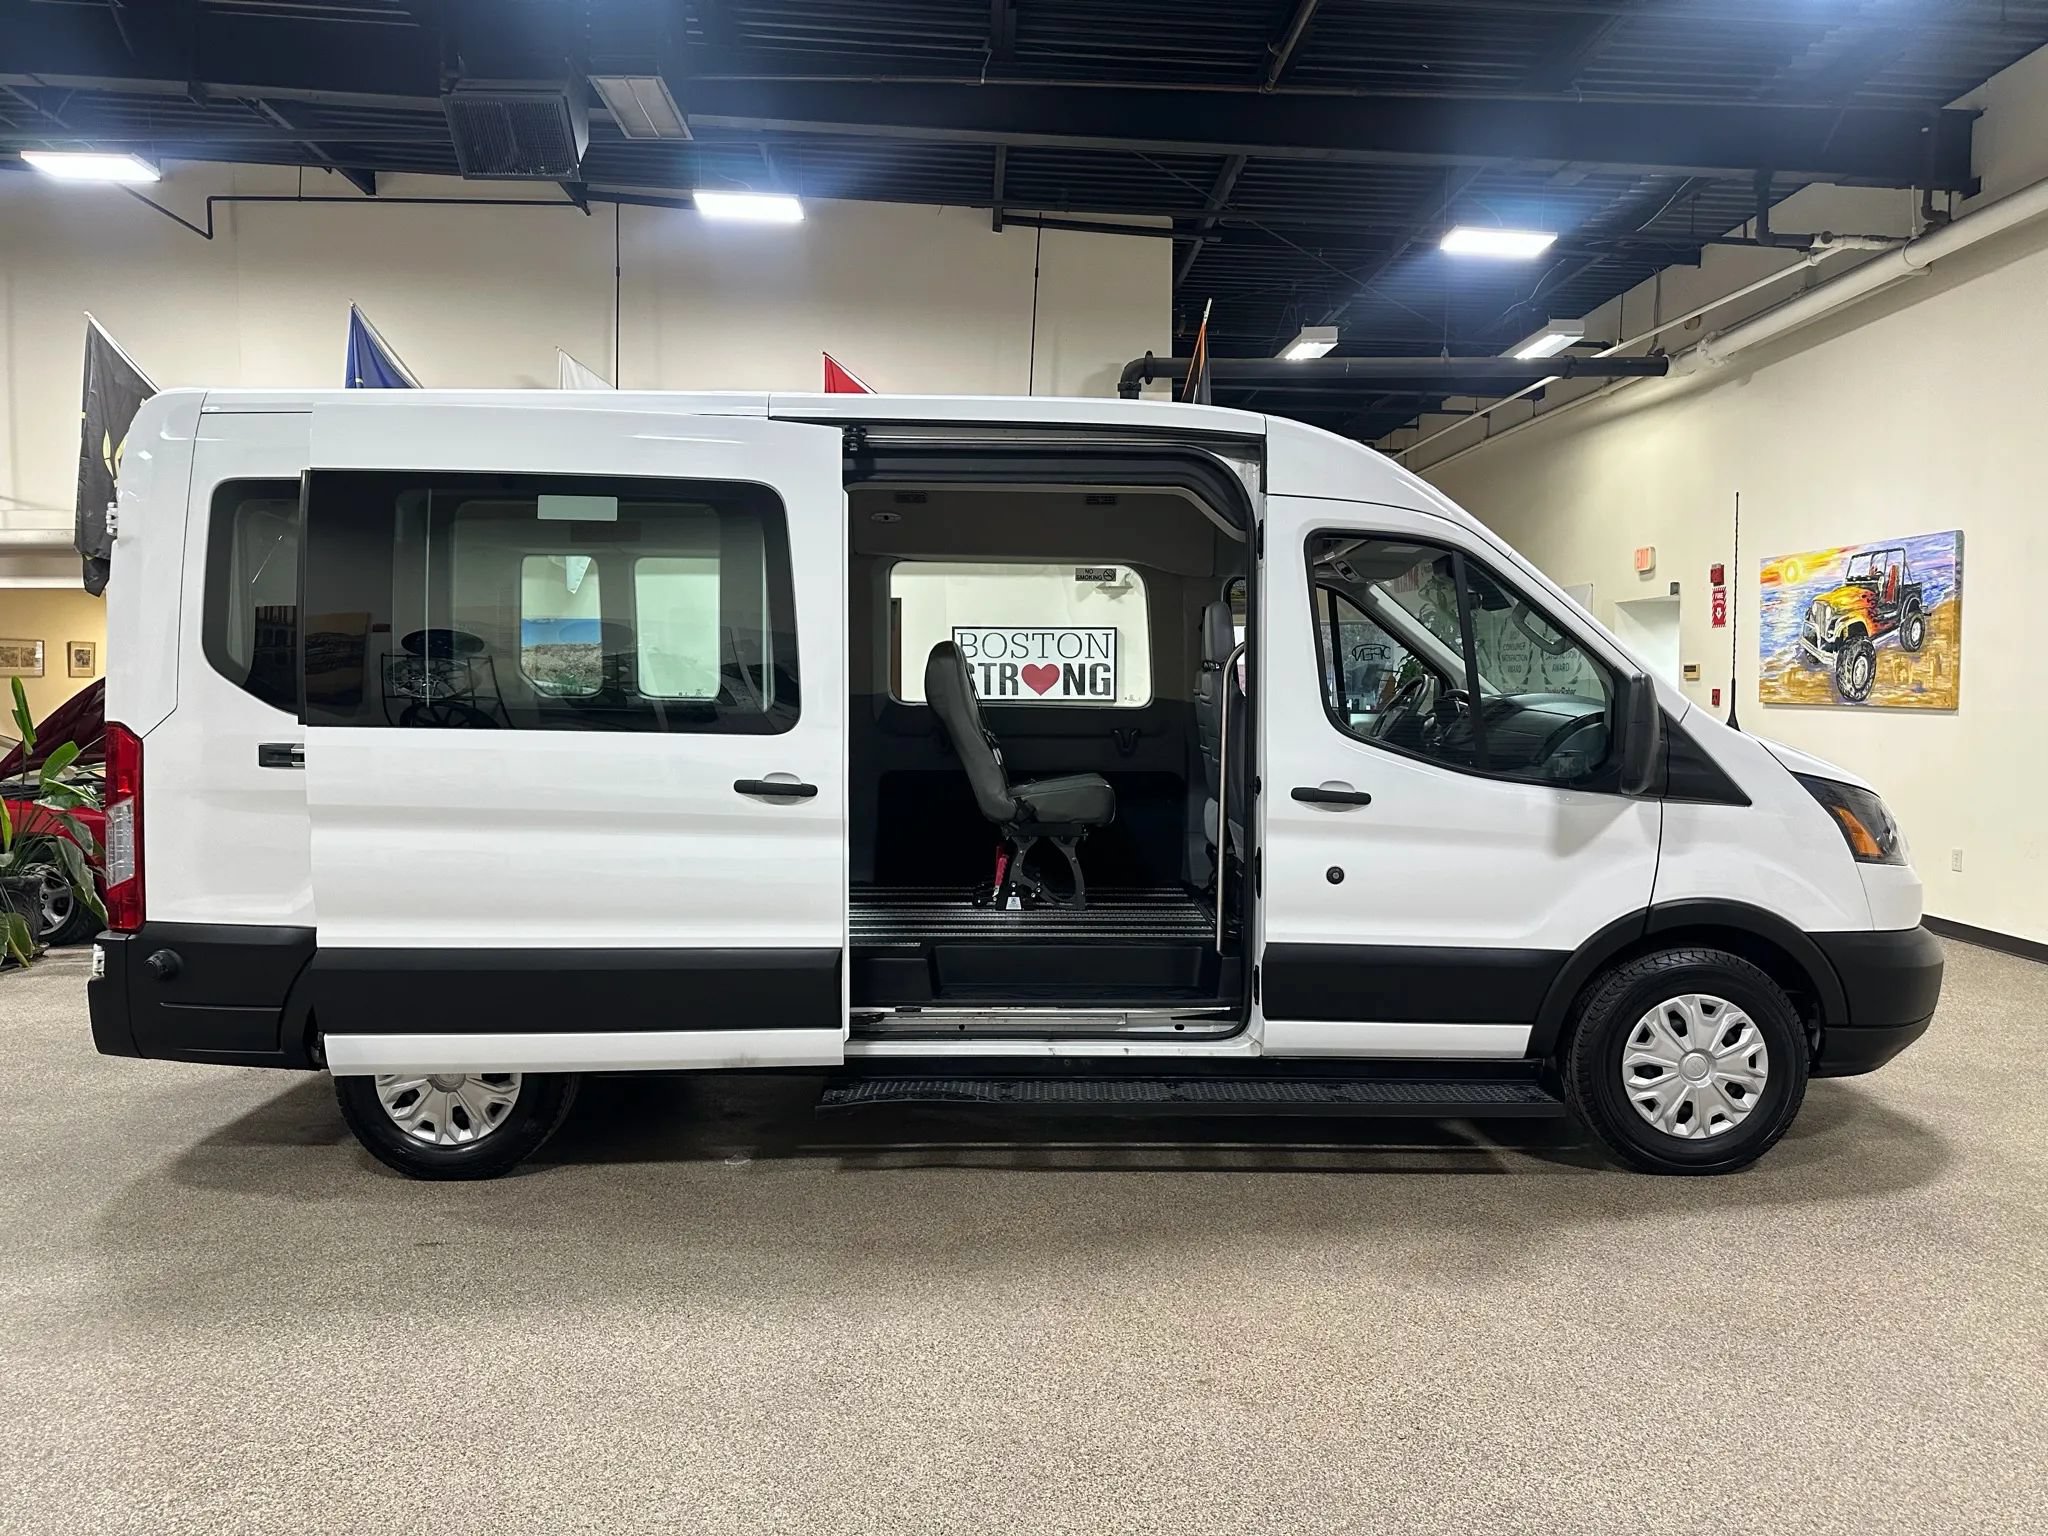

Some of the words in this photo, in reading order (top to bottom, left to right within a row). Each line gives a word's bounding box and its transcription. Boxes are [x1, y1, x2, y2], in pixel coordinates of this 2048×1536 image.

[1714, 592, 1724, 600] FIRE
[957, 632, 1112, 659] BOSTON
[1552, 662, 1570, 673] AWARD
[966, 663, 1111, 696] TRNG
